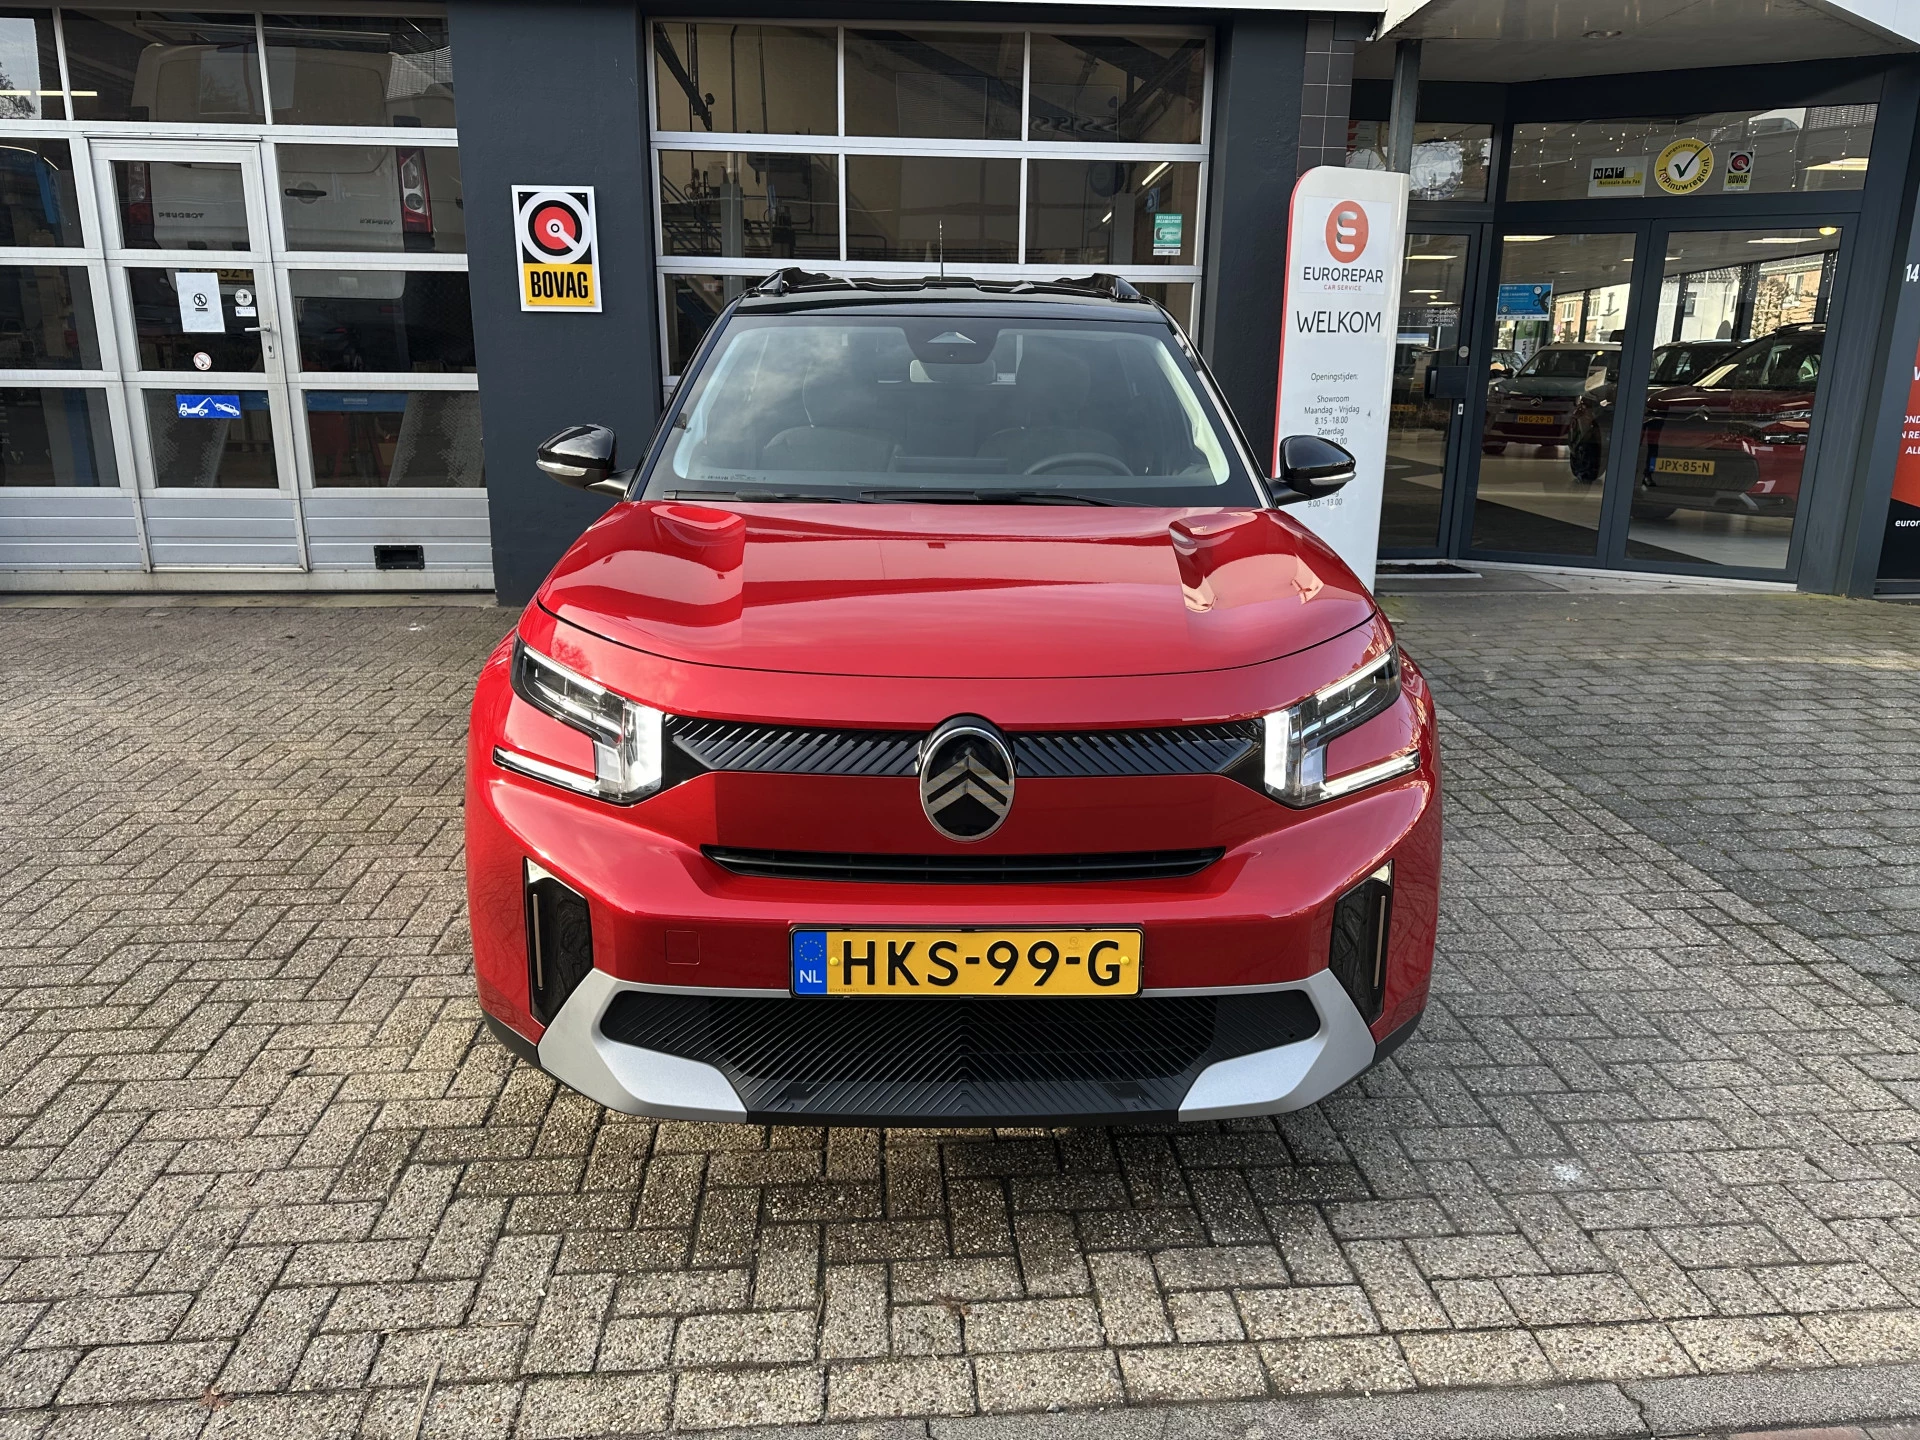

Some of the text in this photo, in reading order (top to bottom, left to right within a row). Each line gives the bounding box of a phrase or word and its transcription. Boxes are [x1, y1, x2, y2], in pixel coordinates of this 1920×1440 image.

[1594, 167, 1625, 179] NAP
[1728, 174, 1748, 184] BOVAG
[1303, 267, 1384, 284] EUROREPAR
[530, 270, 589, 299] BOVAG
[1296, 310, 1382, 333] WELKOM
[1310, 372, 1359, 382] Openingstijden:
[1317, 394, 1350, 403] Showroom
[1304, 406, 1333, 415] Maandag
[1338, 405, 1360, 414] Vrijdag
[1314, 416, 1328, 425] 8.15
[1317, 427, 1345, 437] Zaterdag
[1658, 460, 1710, 473] JPX-85-N
[1307, 499, 1321, 508] 9.00
[1327, 498, 1343, 507] 13.00
[1895, 519, 1920, 527] euror
[843, 940, 1121, 987] HKS-99-G
[799, 969, 823, 984] NL
